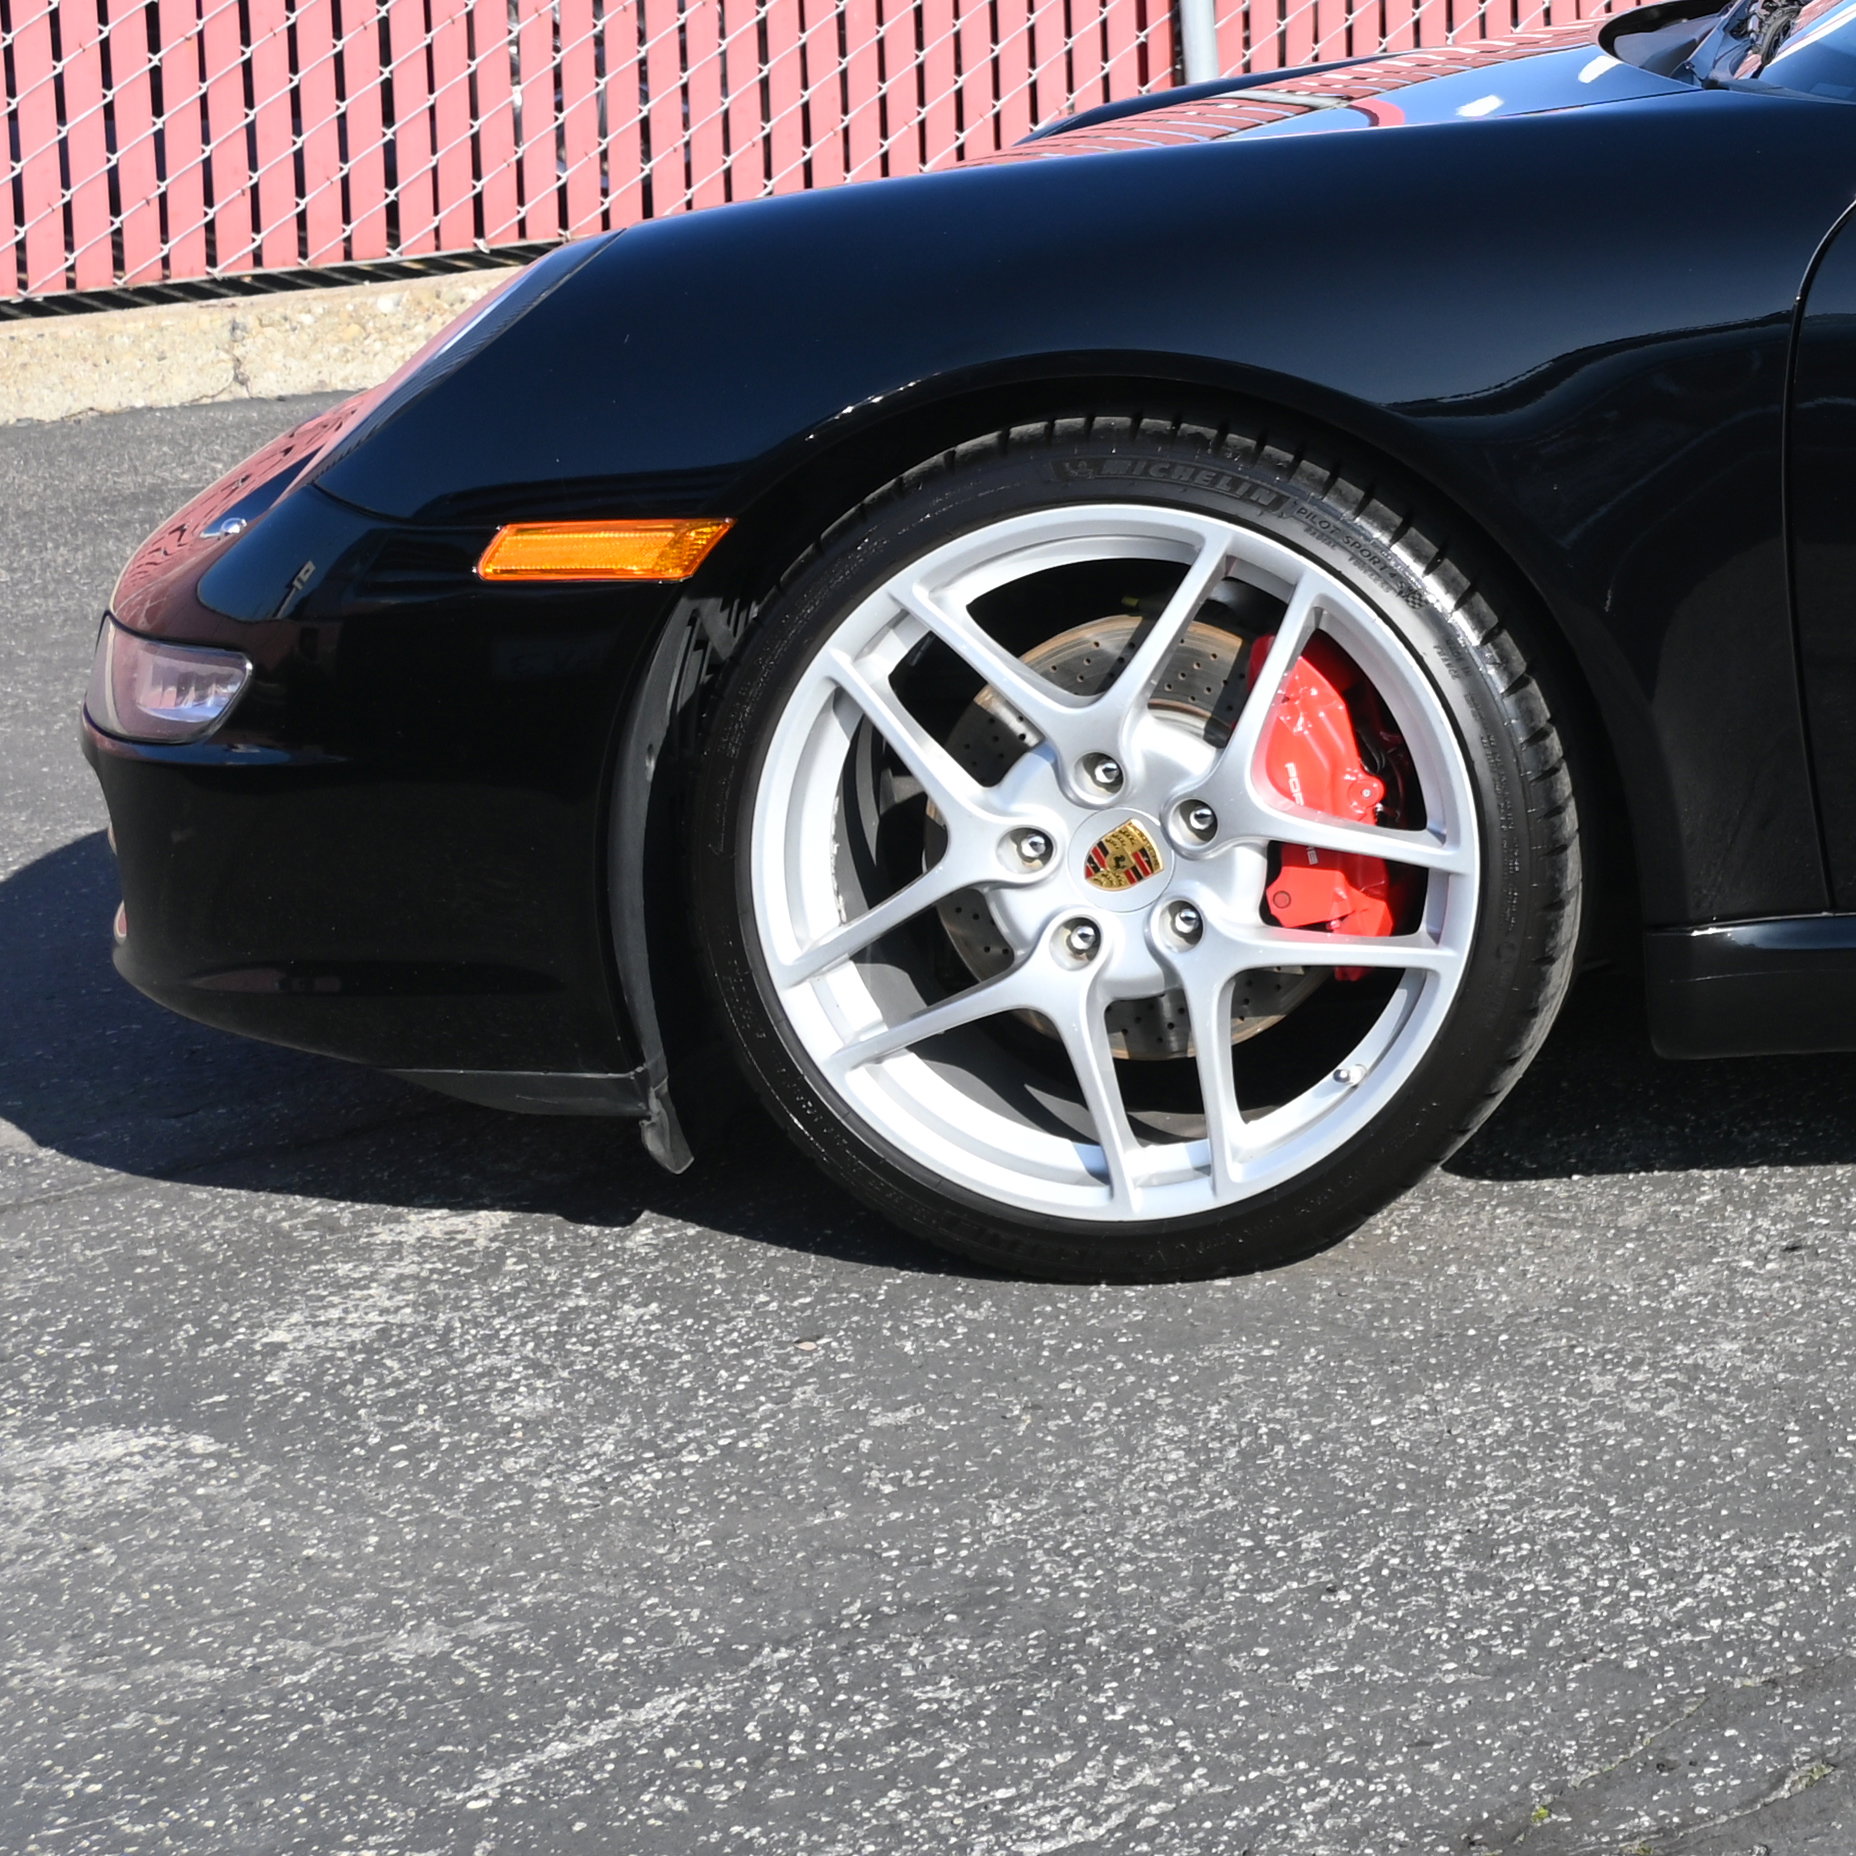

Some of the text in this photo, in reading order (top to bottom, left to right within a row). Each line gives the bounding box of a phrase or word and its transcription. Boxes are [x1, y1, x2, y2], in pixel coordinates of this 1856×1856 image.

[1099, 458, 1278, 506] MICHELIN
[1296, 506, 1341, 535] PILOT
[1342, 534, 1388, 572] SPORT
